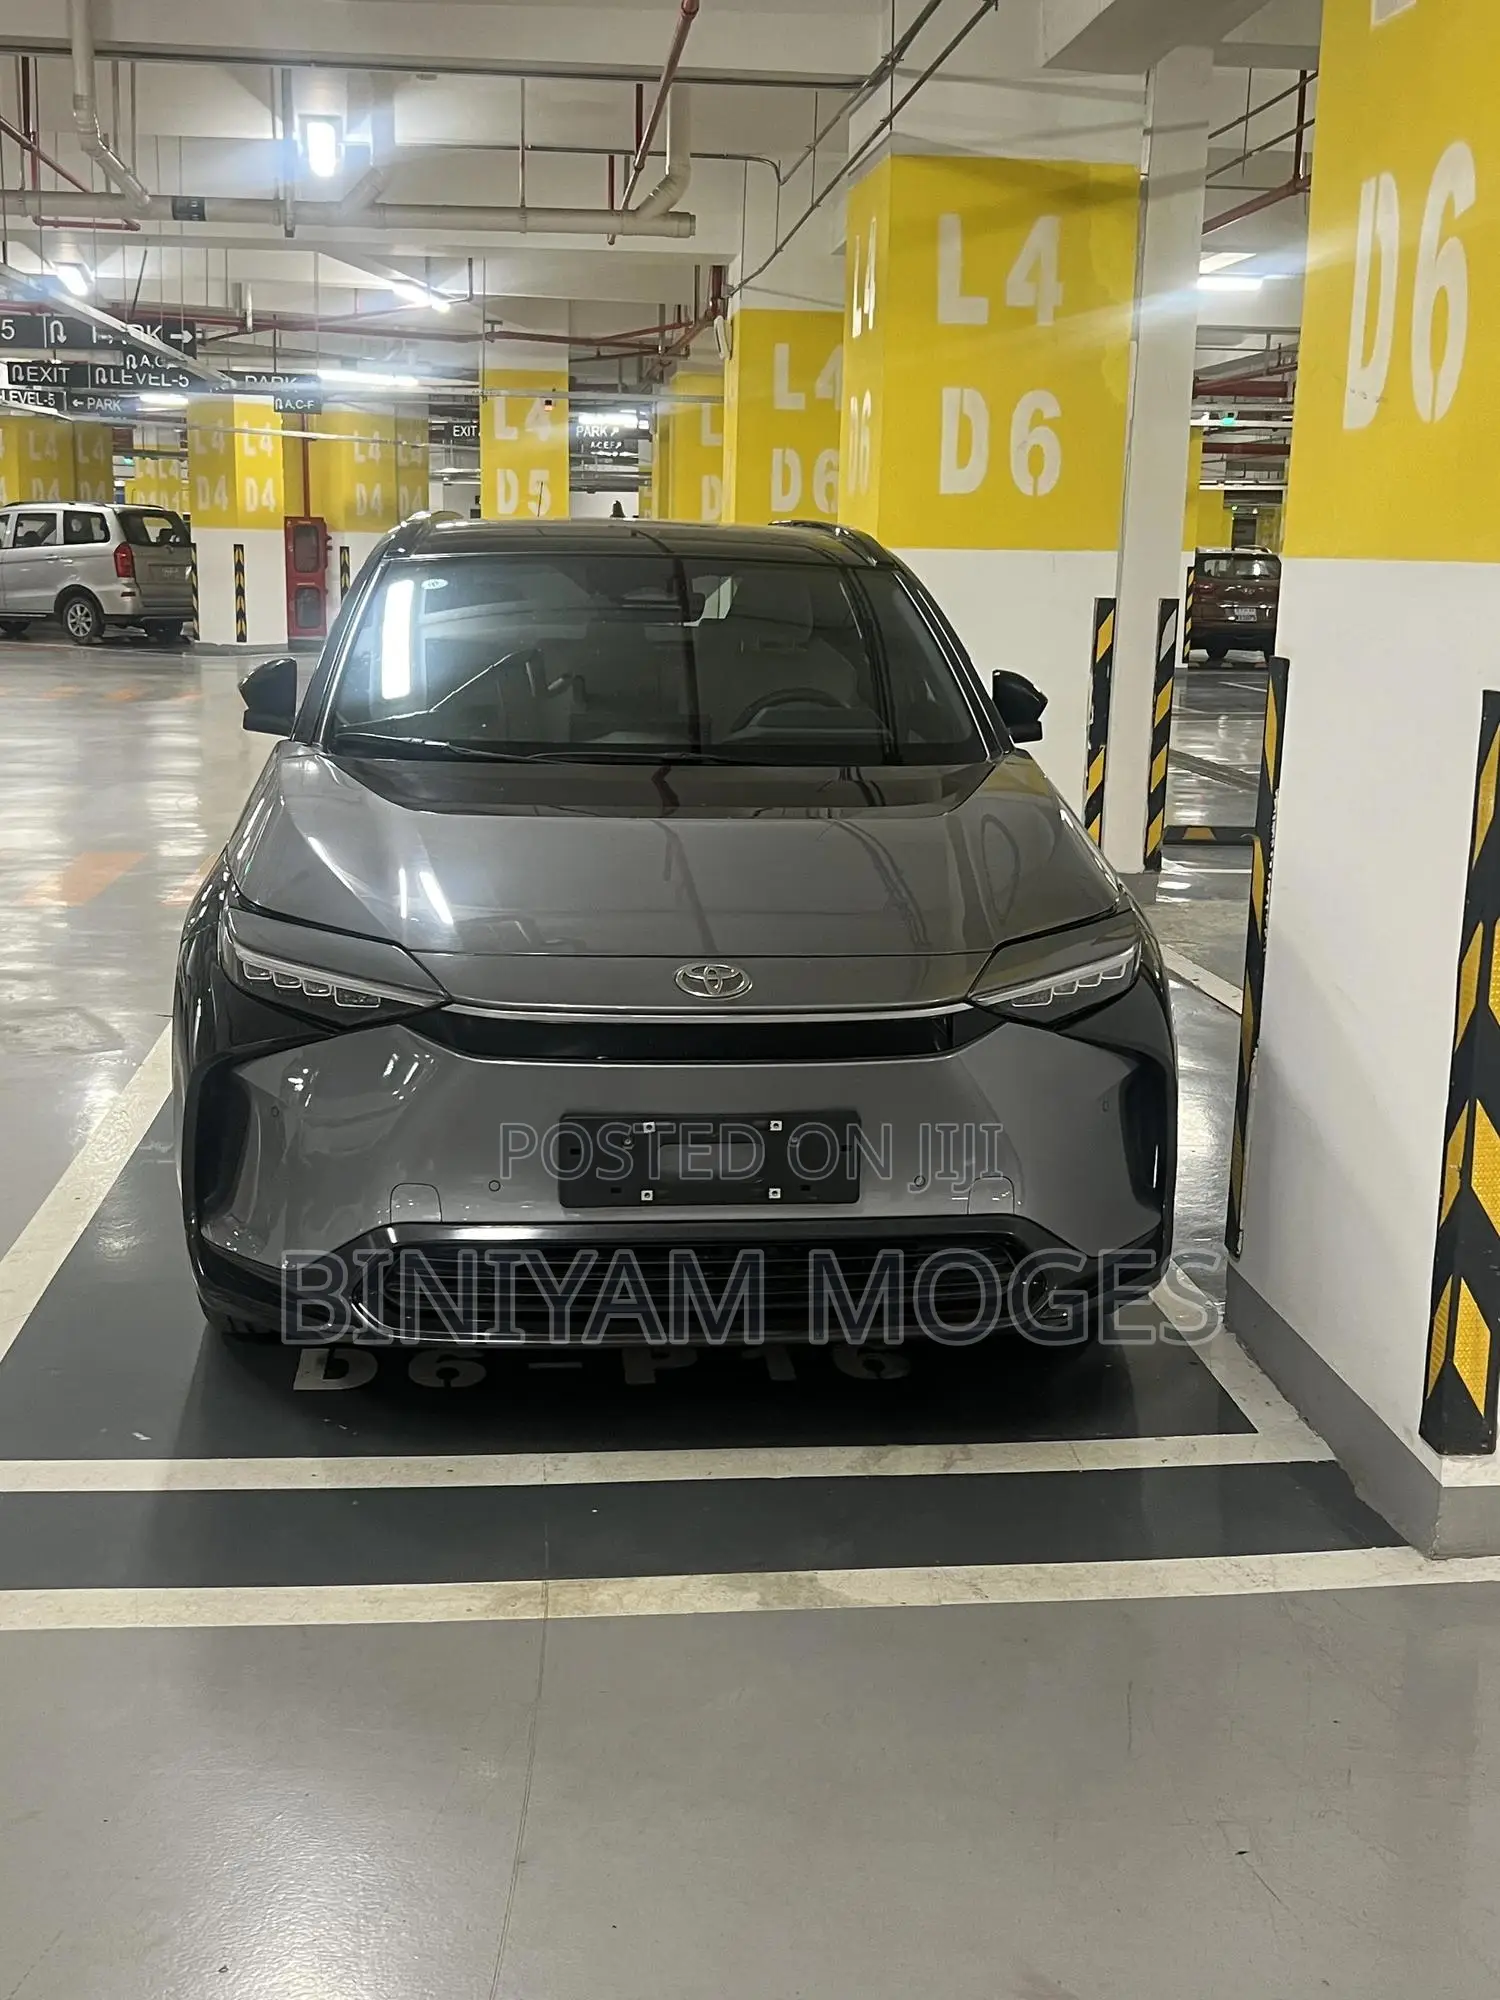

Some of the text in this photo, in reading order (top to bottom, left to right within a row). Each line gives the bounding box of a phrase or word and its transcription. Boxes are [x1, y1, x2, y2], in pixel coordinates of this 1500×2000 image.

[937, 213, 1063, 326] L4
[1343, 141, 1476, 431] D6
[26, 366, 70, 383] EXIT
[87, 397, 122, 412] PARK
[453, 425, 477, 437] EXIT
[576, 425, 607, 438] PARK
[939, 387, 1062, 497] D6
[245, 477, 276, 513] D4
[496, 468, 551, 516] D5
